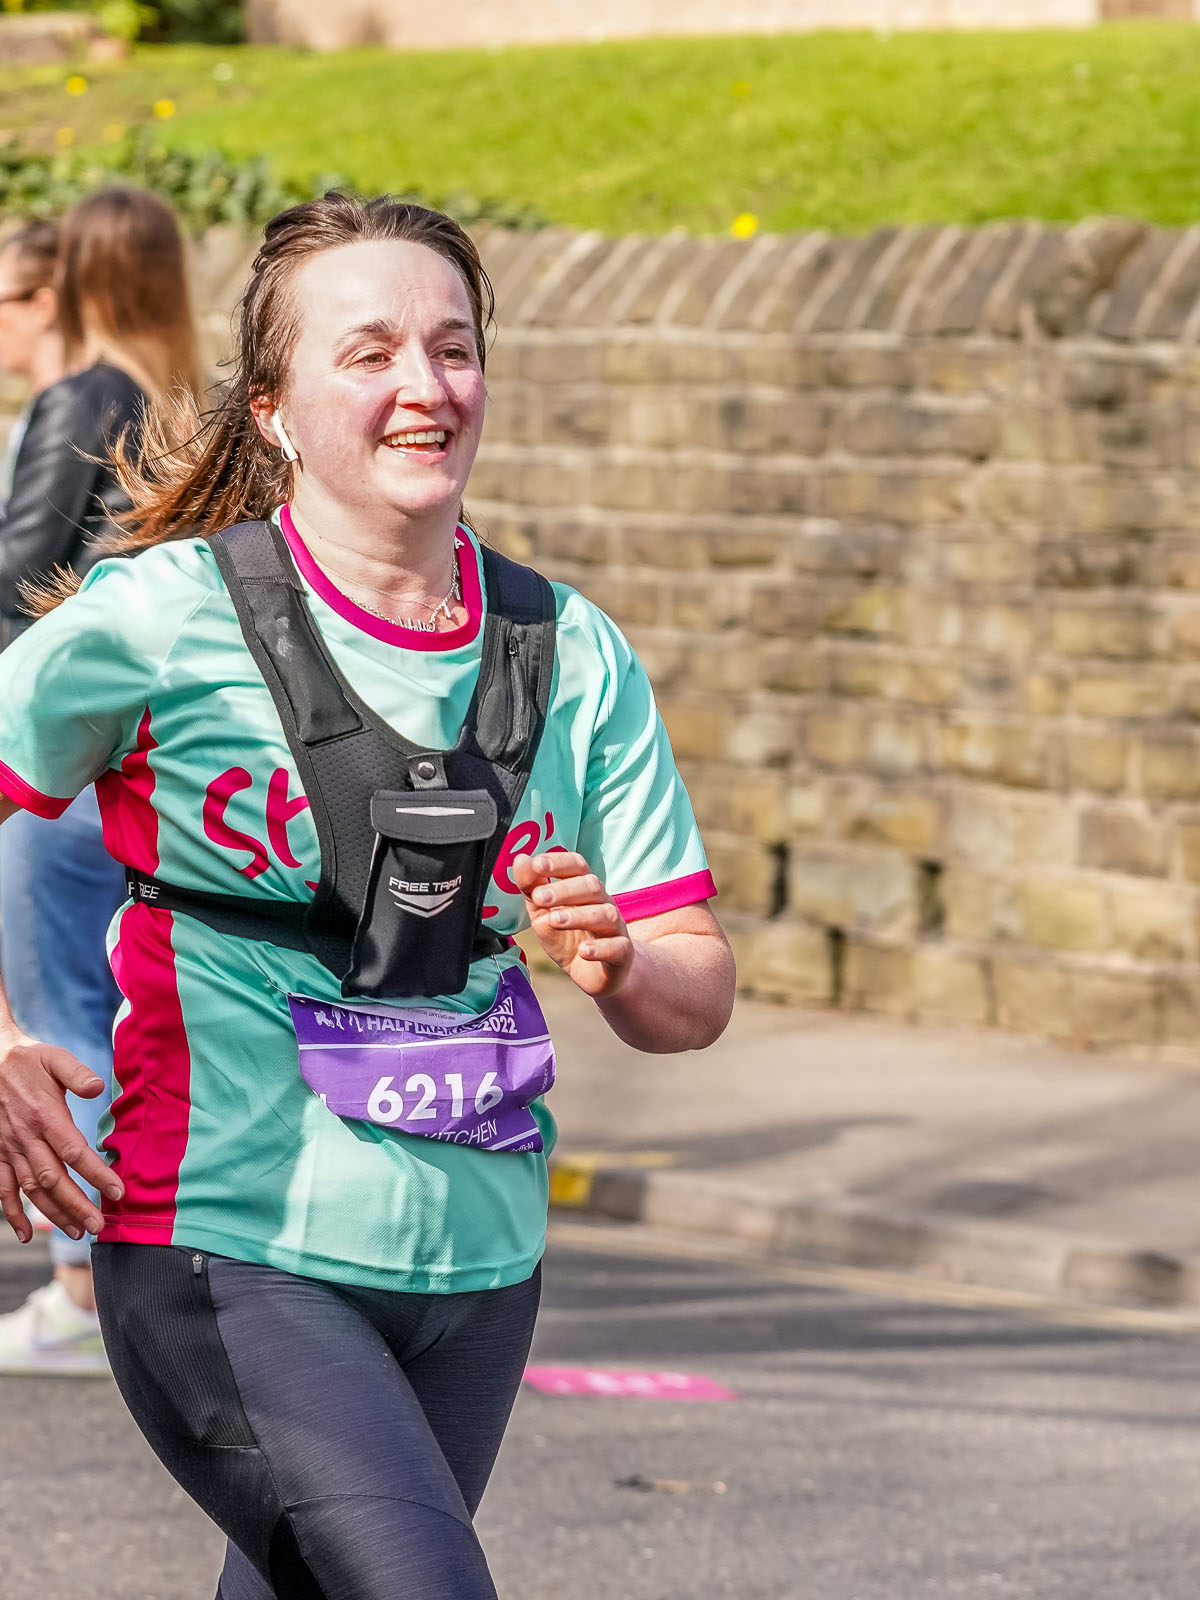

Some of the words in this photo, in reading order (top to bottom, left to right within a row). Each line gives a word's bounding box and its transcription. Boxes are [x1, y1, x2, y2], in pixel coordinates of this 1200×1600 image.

[389, 876, 430, 893] FREE
[481, 1015, 519, 1035] 2022
[366, 1071, 504, 1124] 6216
